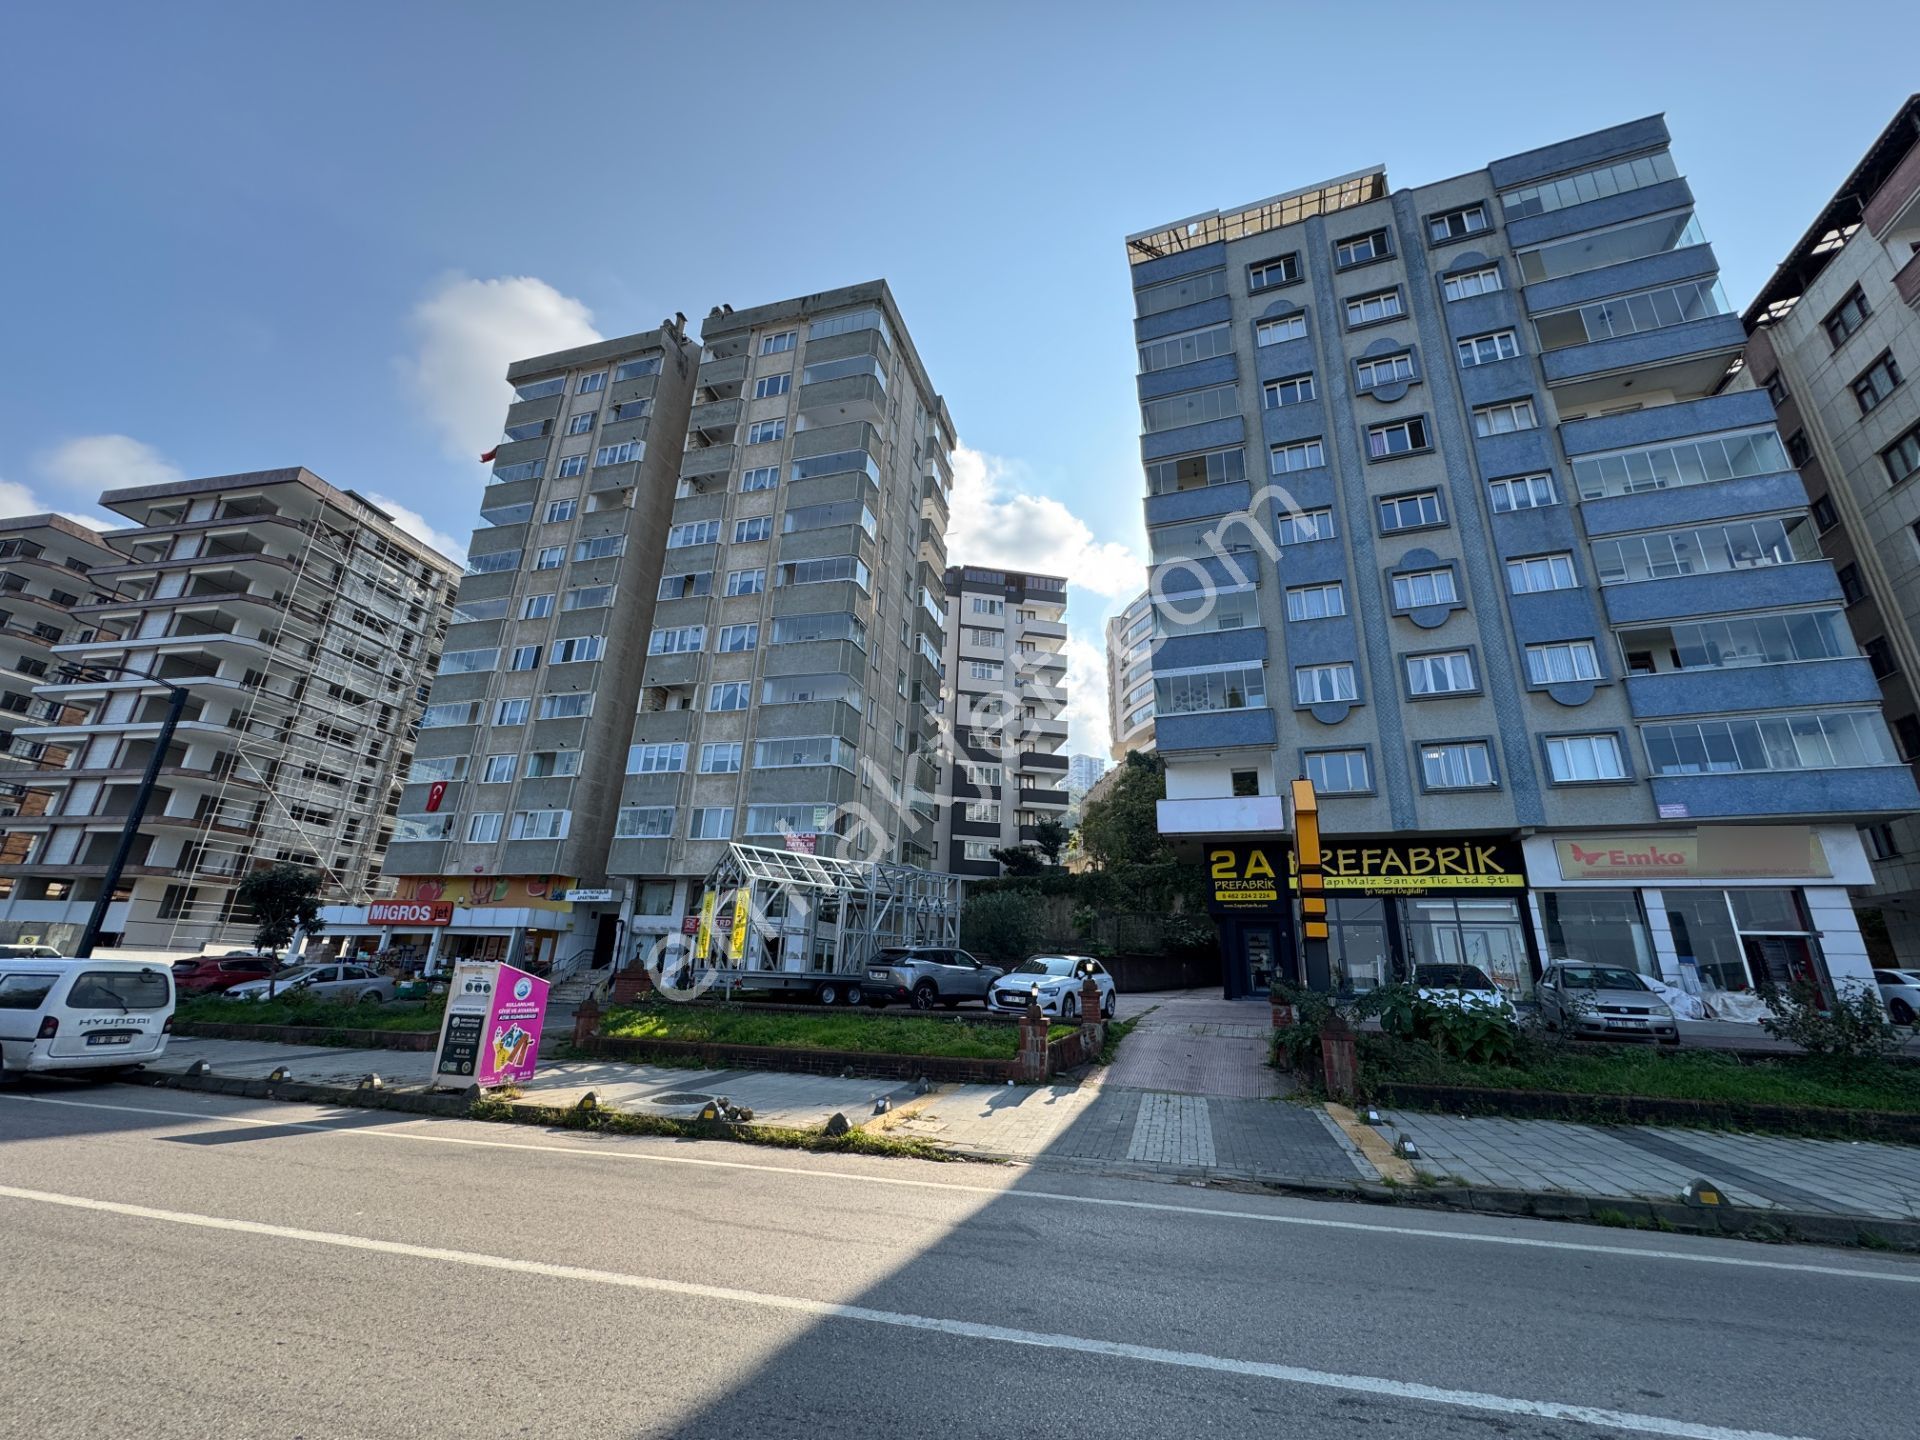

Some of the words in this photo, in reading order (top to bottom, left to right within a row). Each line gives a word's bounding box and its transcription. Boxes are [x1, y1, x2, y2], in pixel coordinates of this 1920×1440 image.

[1608, 846, 1685, 865] Emko
[1210, 850, 1276, 879] 2A
[1214, 878, 1276, 890] PREFABRİK
[1323, 878, 1344, 888] apı
[1347, 877, 1380, 885] Malz.
[1429, 876, 1452, 884] Tic.
[1455, 876, 1484, 884] Ltd.
[1487, 875, 1515, 886] Şti.
[431, 906, 449, 921] jet
[79, 1018, 150, 1026] HYUNDAI
